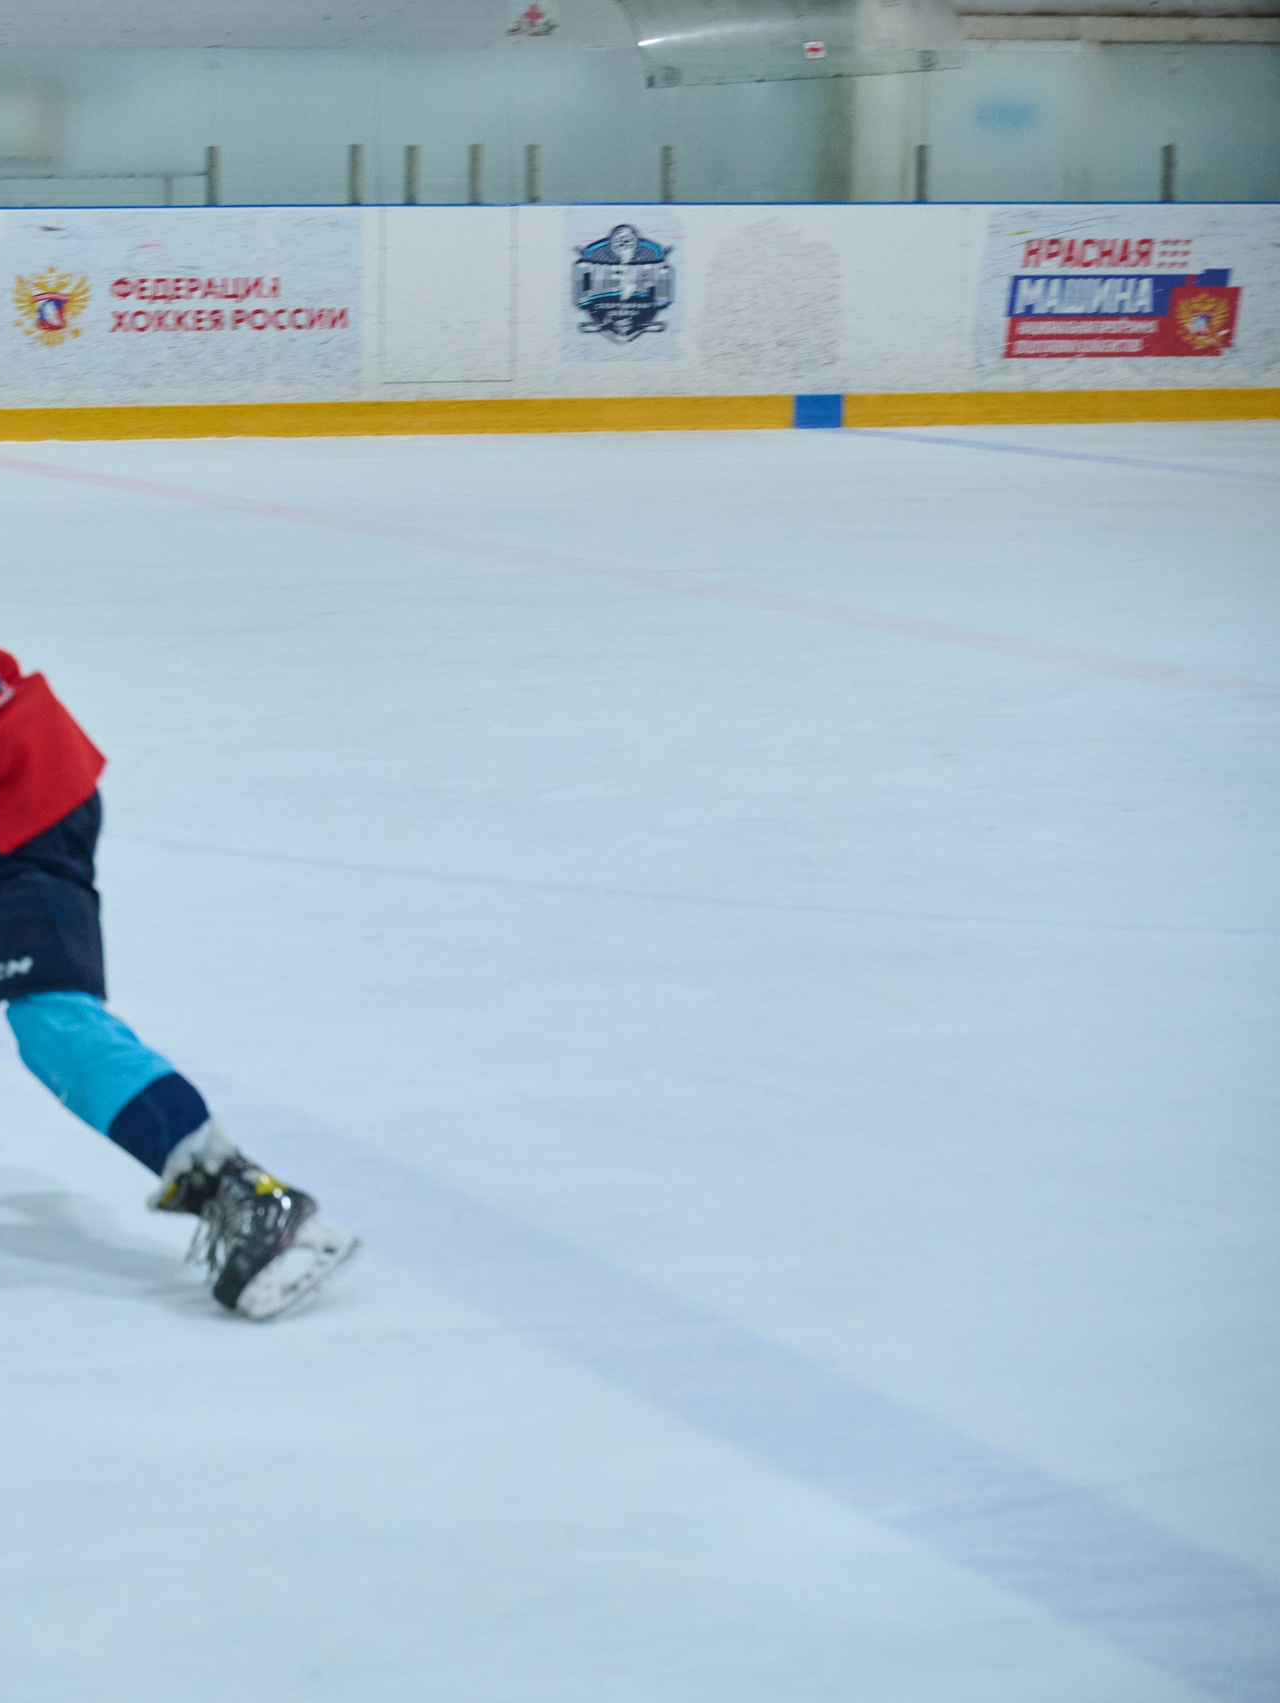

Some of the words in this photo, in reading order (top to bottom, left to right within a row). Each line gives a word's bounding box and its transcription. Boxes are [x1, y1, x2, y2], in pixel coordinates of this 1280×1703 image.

[1022, 238, 1154, 268] КРАСНАЯ
[1015, 278, 1154, 315] МАШИНА
[108, 310, 224, 333] ХОККЕЯ
[231, 308, 349, 331] РОССИИ
